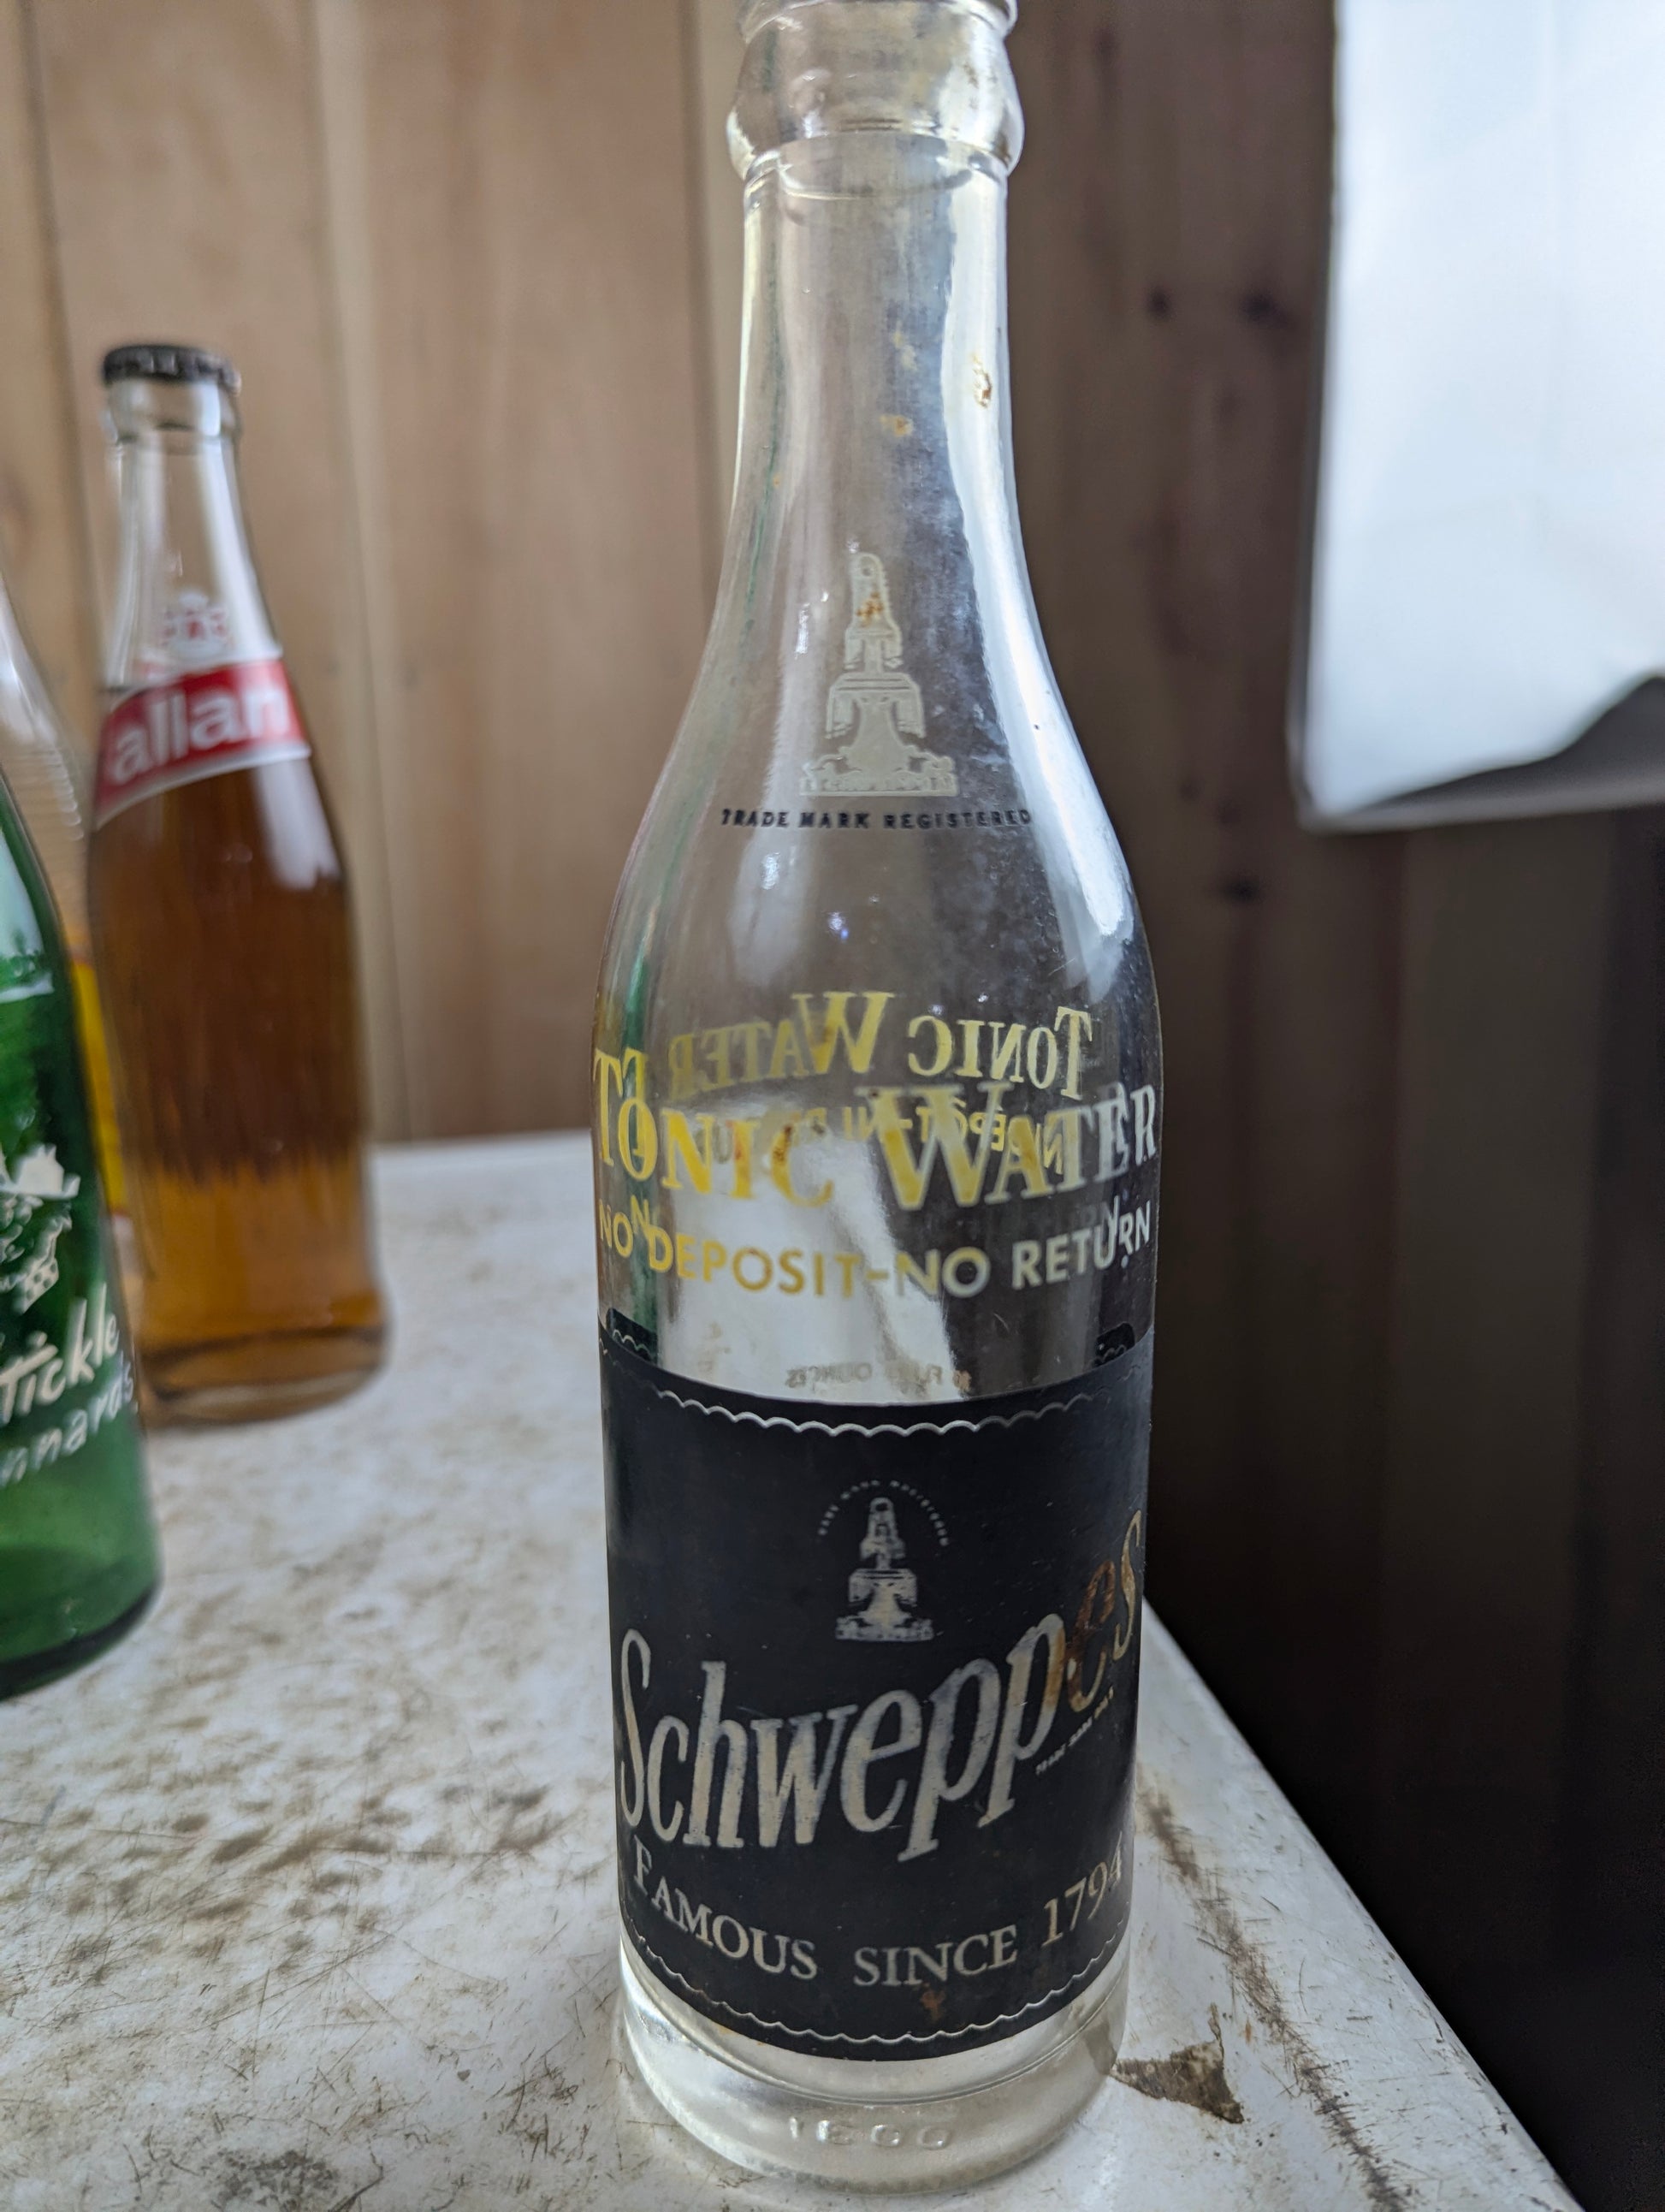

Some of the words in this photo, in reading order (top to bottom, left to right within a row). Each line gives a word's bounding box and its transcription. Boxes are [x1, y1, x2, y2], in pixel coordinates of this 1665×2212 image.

[721, 809, 789, 827] TRADE
[798, 811, 871, 829] MARK
[884, 809, 1032, 830] REGISTERED
[594, 1049, 833, 1207] TONIC
[856, 1083, 1158, 1210] WATER
[599, 1198, 634, 1258] NO
[1012, 1200, 1151, 1290] RETURN
[0, 1283, 120, 1426] Tickle
[619, 1509, 1142, 1863] Schweppes
[633, 1836, 818, 1980] FAMOUS
[853, 1924, 1018, 1988] SINCE
[1041, 1830, 1123, 1947] 1794
